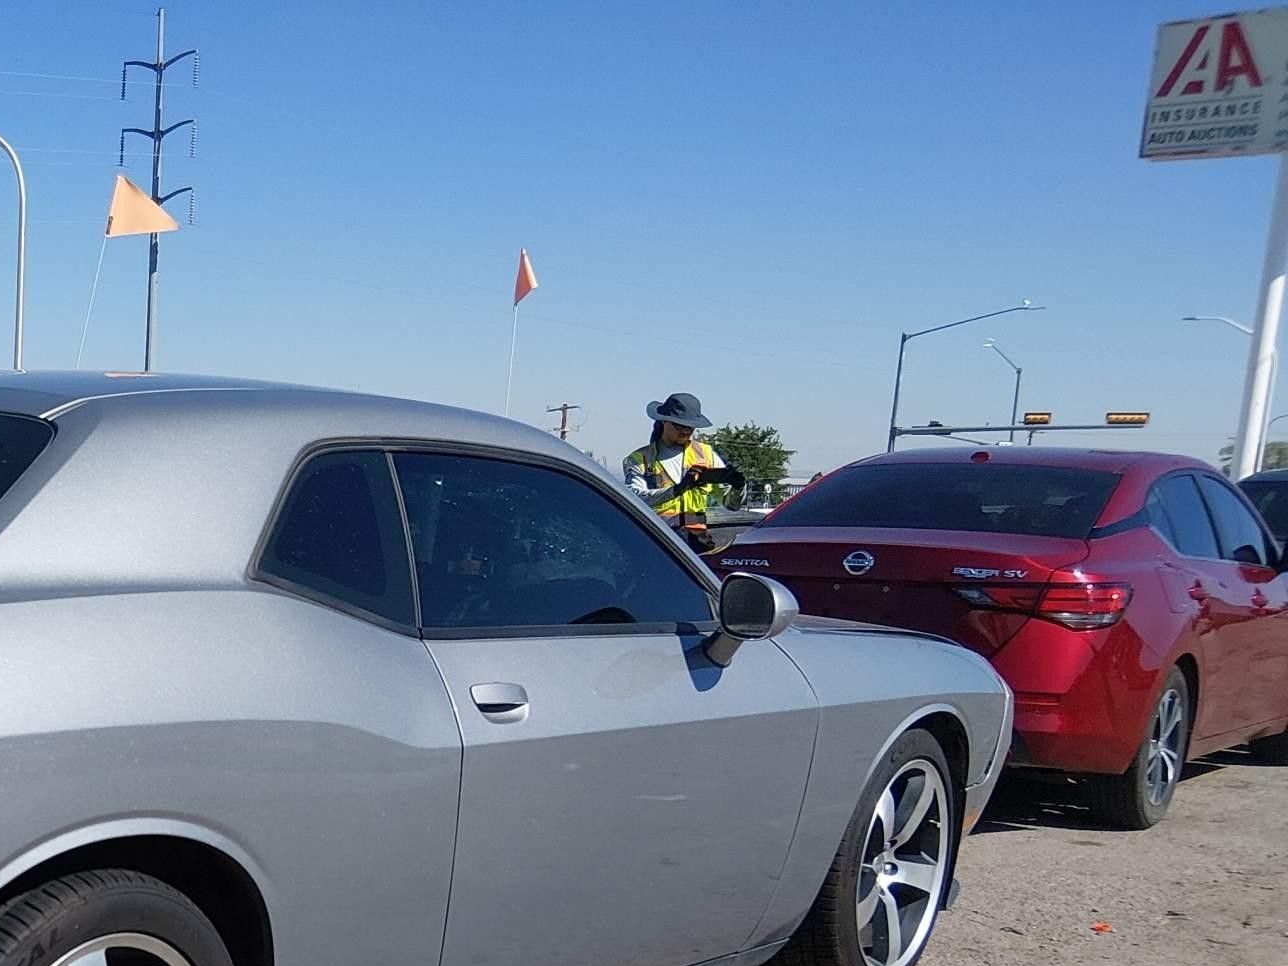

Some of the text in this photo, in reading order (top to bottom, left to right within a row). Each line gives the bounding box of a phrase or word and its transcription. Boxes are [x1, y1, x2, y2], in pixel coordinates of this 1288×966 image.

[1151, 101, 1261, 123] INSURANCE
[1148, 124, 1258, 144] AUTO AUCTIONS
[720, 558, 770, 567] SENTRA
[1003, 570, 1029, 578] SV
